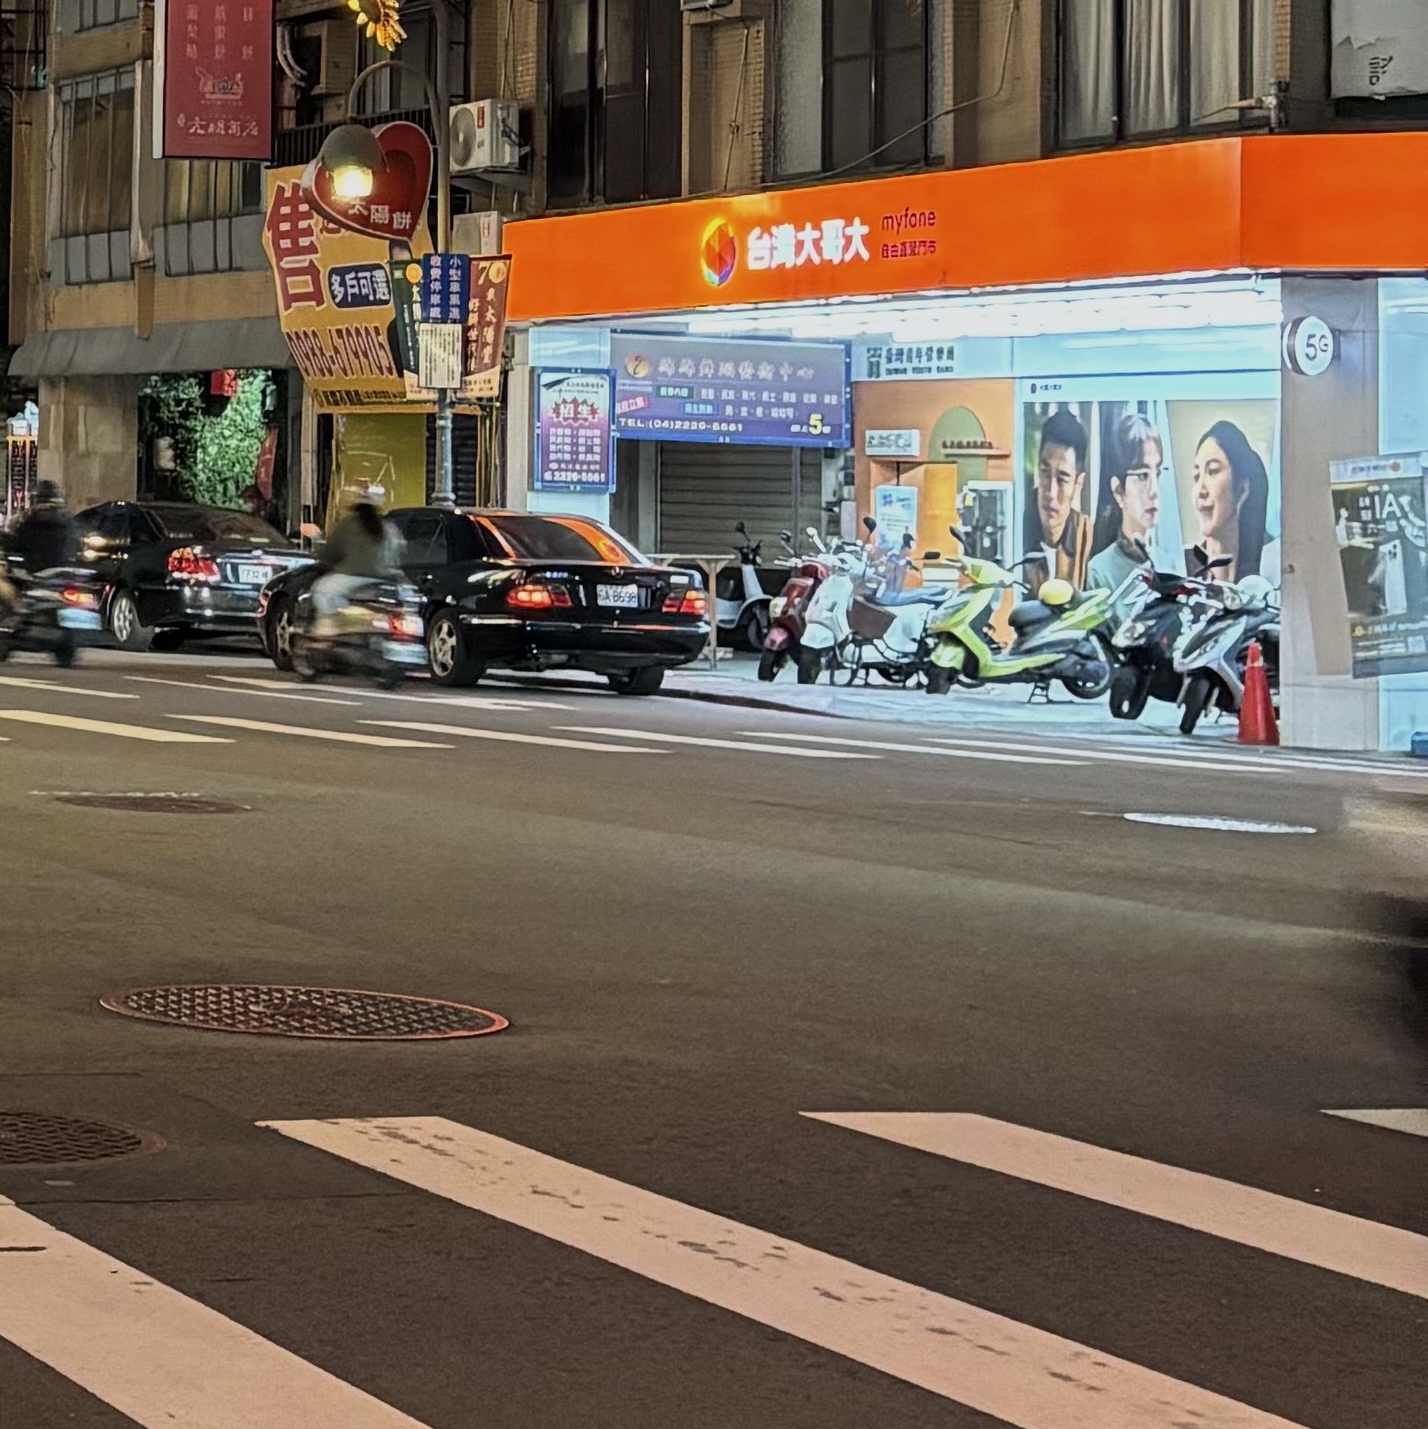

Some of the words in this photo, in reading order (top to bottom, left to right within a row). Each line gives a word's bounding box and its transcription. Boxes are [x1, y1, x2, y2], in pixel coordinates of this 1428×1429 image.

[880, 205, 937, 235] myfone
[746, 215, 870, 272] 台灣大哥大
[329, 268, 392, 305] 多戶可選
[1304, 333, 1330, 362] 5G
